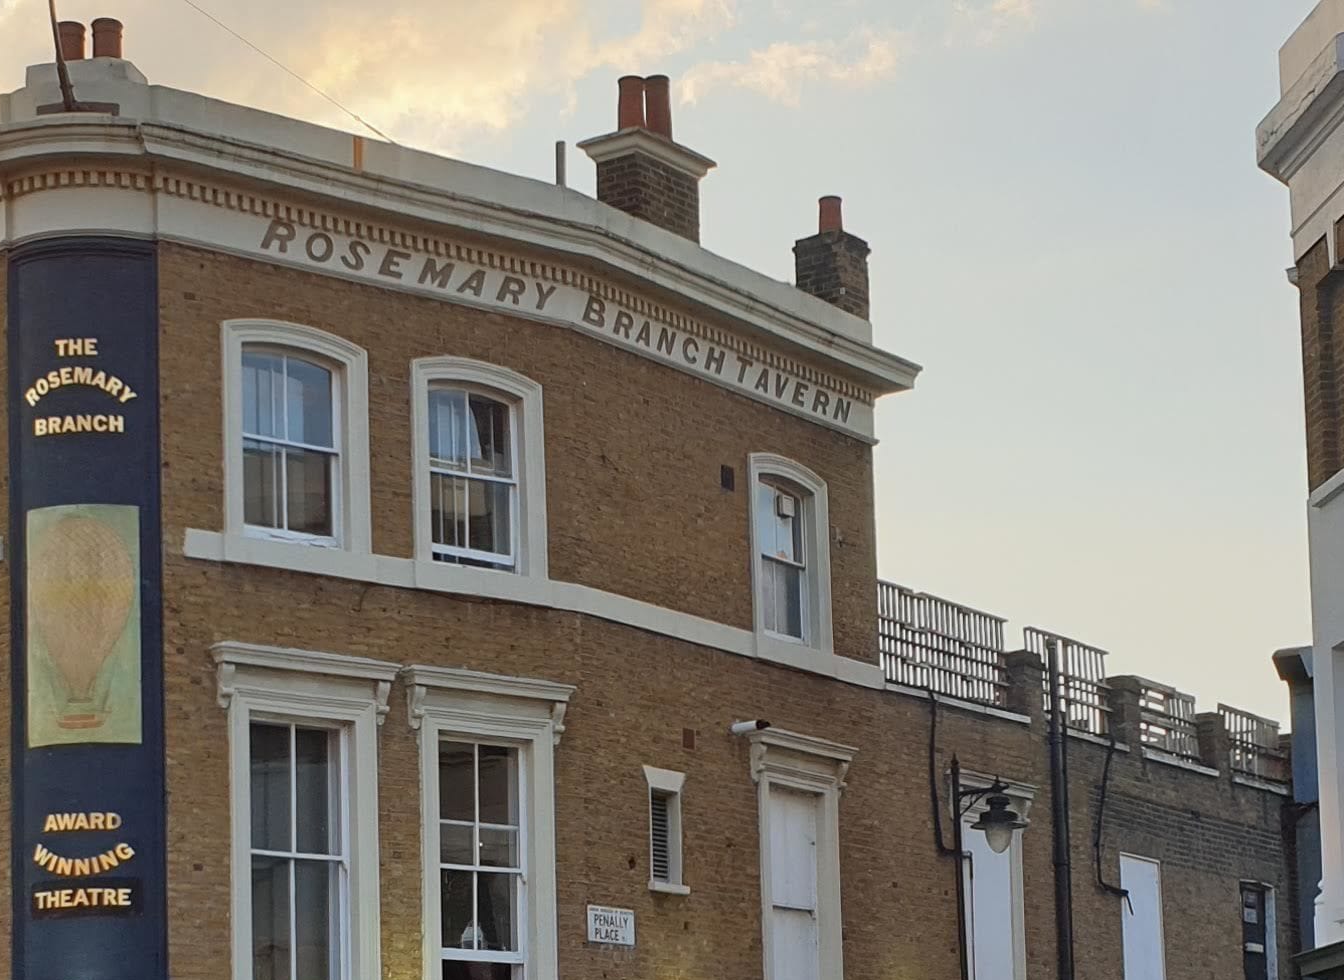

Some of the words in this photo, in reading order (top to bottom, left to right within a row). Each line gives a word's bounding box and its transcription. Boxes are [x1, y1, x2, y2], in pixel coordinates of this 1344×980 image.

[260, 219, 556, 310] ROSEMARY
[581, 295, 726, 374] BRANCH
[736, 356, 851, 424] TAVERN
[55, 338, 98, 356] THE
[24, 366, 137, 407] ROSEMARY
[35, 414, 124, 436] BRANCH
[43, 812, 122, 832] AWARD
[33, 843, 135, 876] WINNING
[34, 888, 132, 909] THEATRE
[594, 914, 628, 929] PENALLY
[594, 927, 619, 941] PLACE
